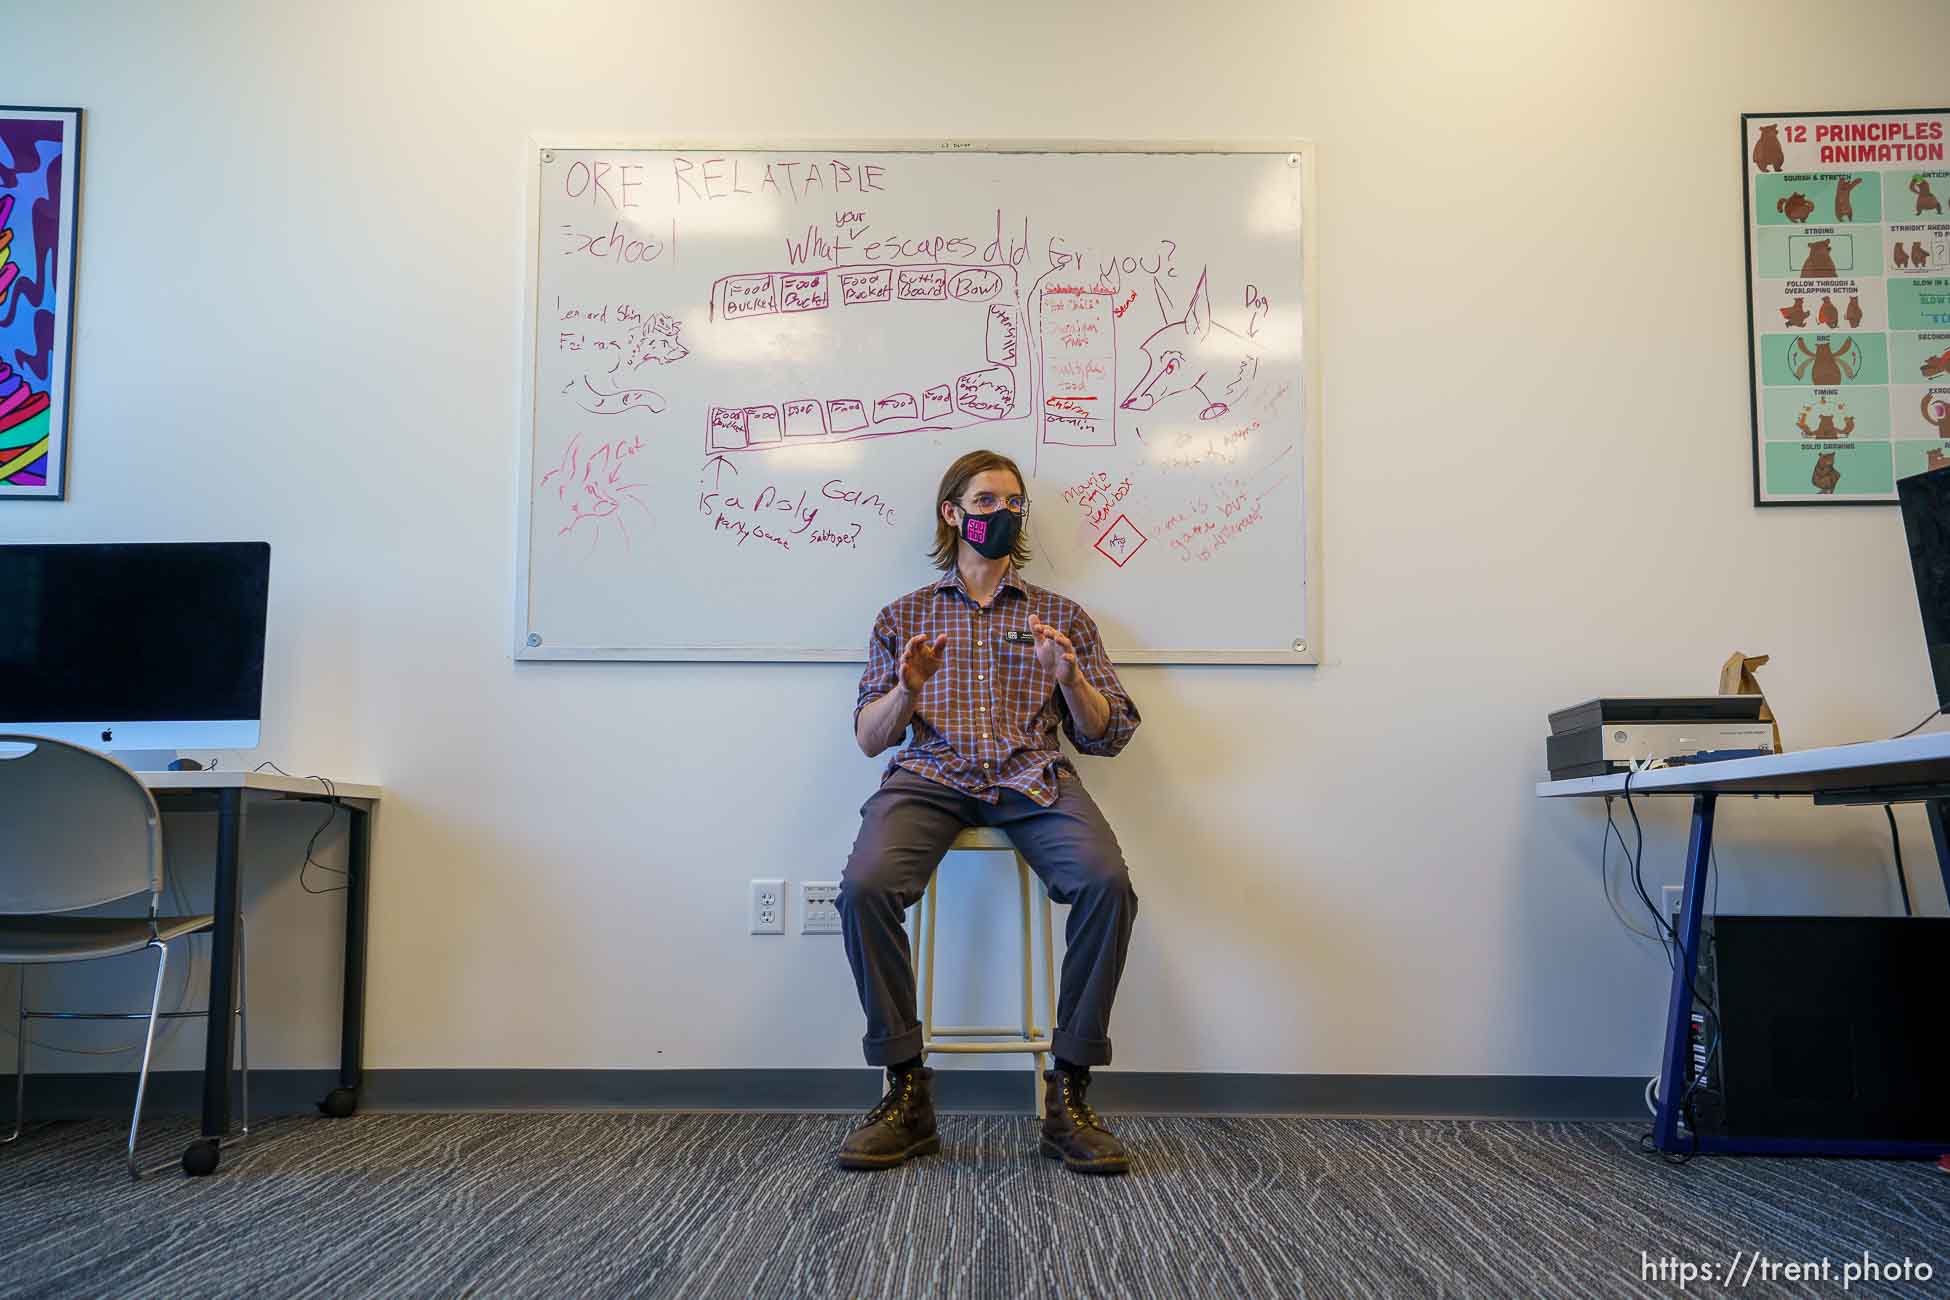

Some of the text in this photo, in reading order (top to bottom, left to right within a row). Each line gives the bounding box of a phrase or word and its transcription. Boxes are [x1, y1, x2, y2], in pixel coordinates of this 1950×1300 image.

[1784, 122, 1943, 143] 12 PRINCIPLES
[1821, 143, 1943, 163] ANIMATION
[673, 158, 886, 204] RELATABLE
[786, 224, 852, 265] What
[1246, 284, 1269, 316] Dog
